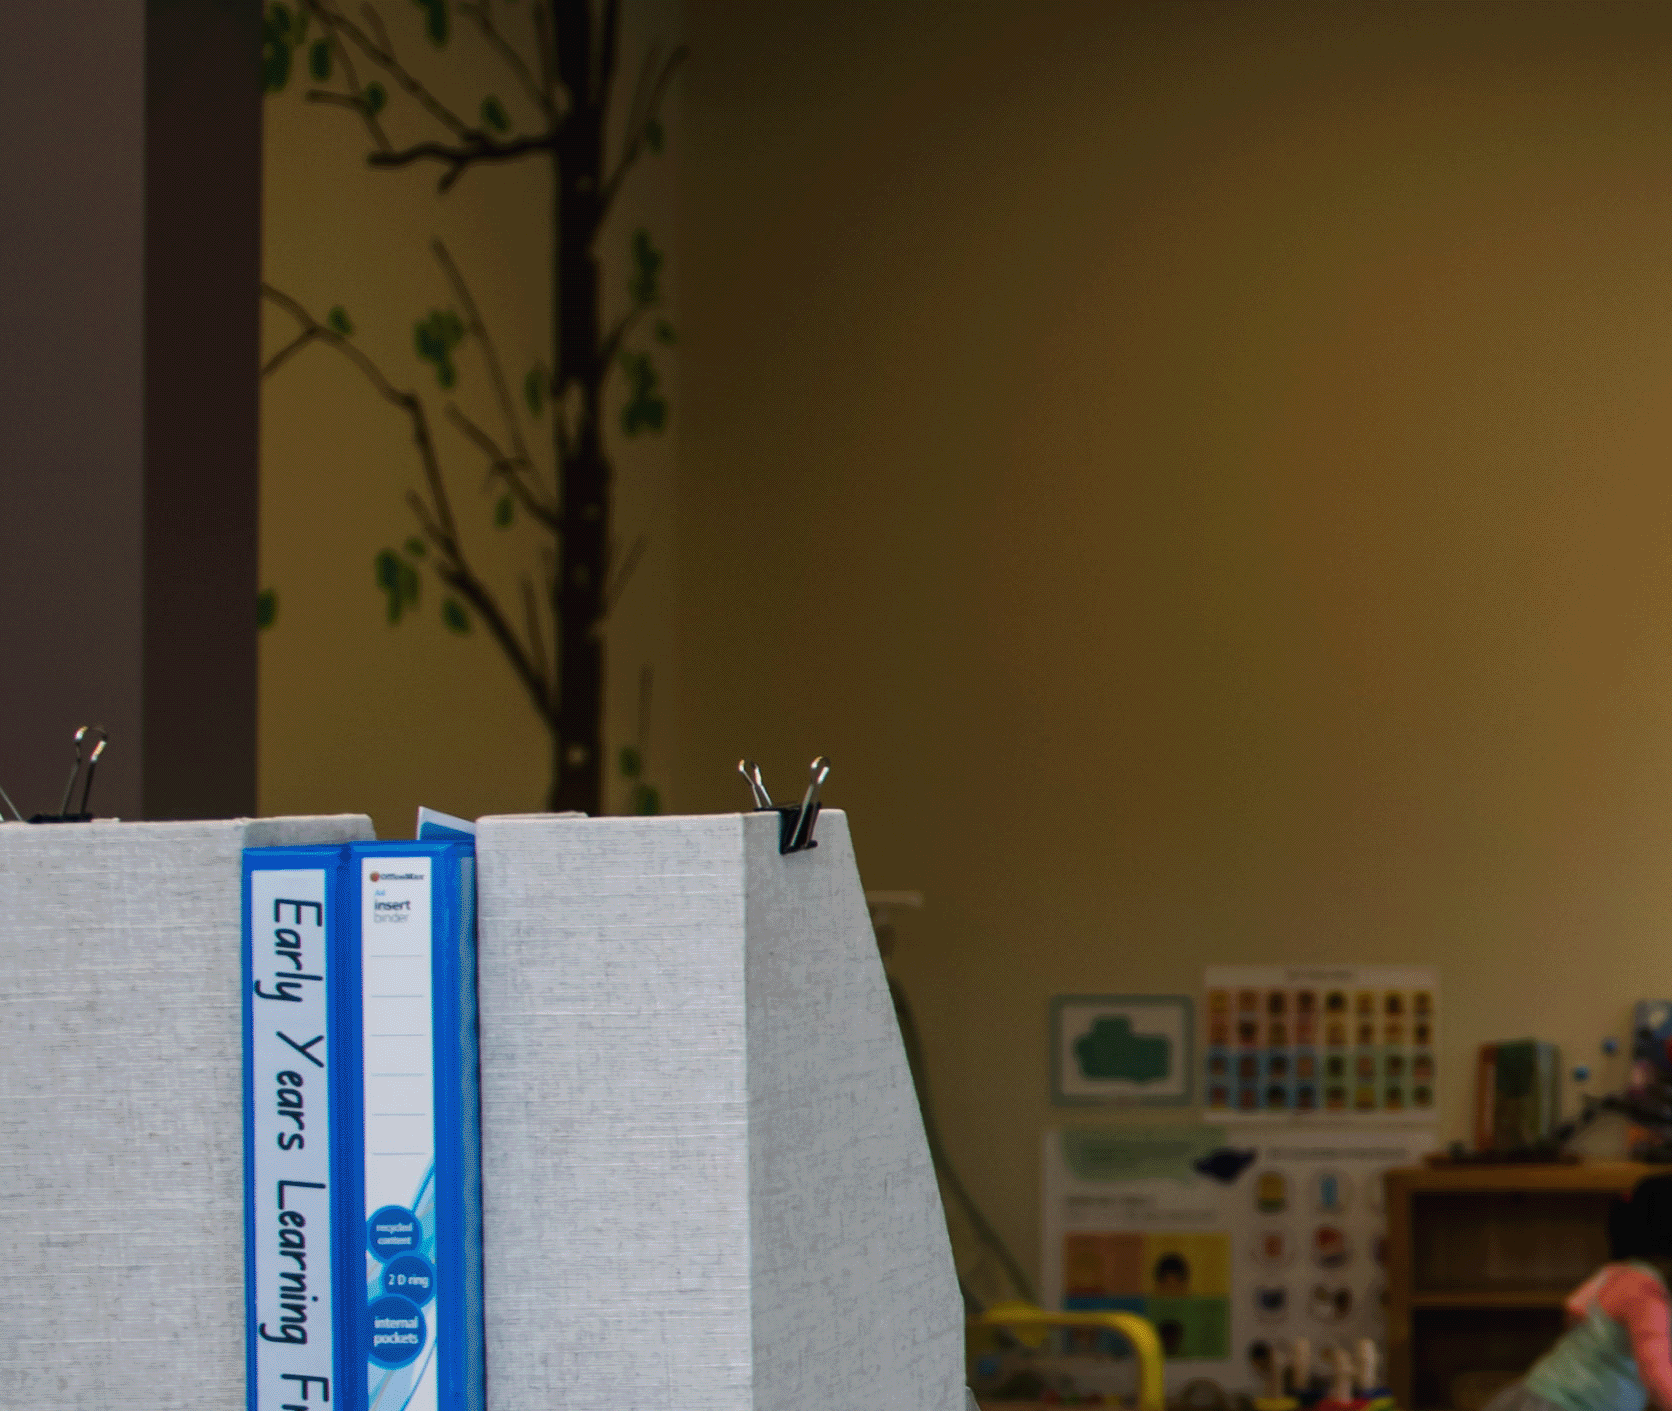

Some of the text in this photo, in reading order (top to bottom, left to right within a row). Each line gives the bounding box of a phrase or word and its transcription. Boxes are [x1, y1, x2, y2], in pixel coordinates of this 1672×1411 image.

[374, 900, 411, 911] insert
[254, 898, 323, 1003] Early
[275, 1031, 325, 1151] Years
[258, 1180, 327, 1345] Learning
[373, 1331, 419, 1347] pockets
[374, 1316, 419, 1329] internal
